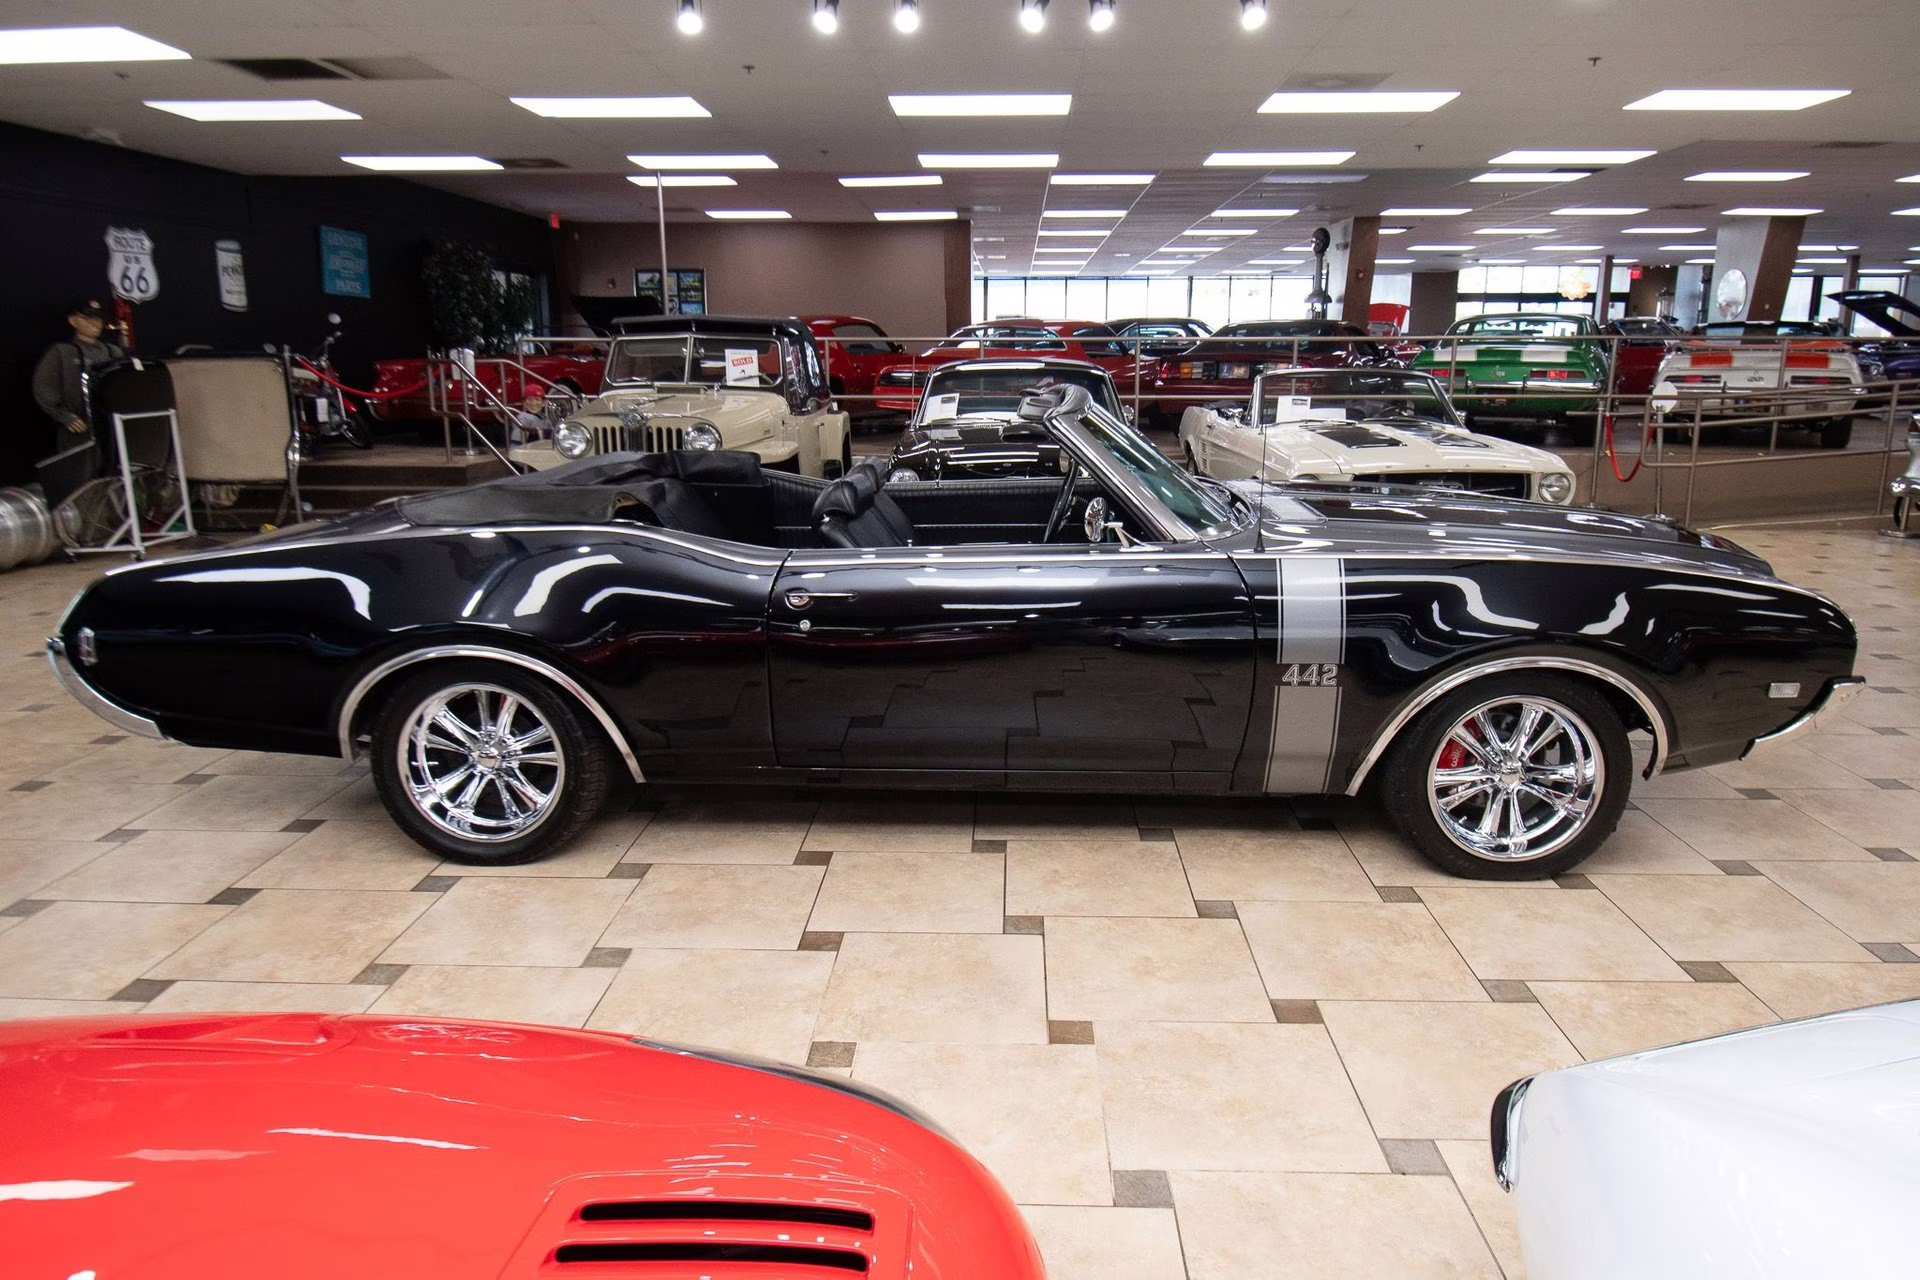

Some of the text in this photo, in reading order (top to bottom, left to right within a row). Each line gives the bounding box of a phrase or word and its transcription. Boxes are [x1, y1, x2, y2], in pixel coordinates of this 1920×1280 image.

[112, 235, 147, 251] ROUTE
[121, 266, 150, 294] 66
[1282, 663, 1339, 687] 442
